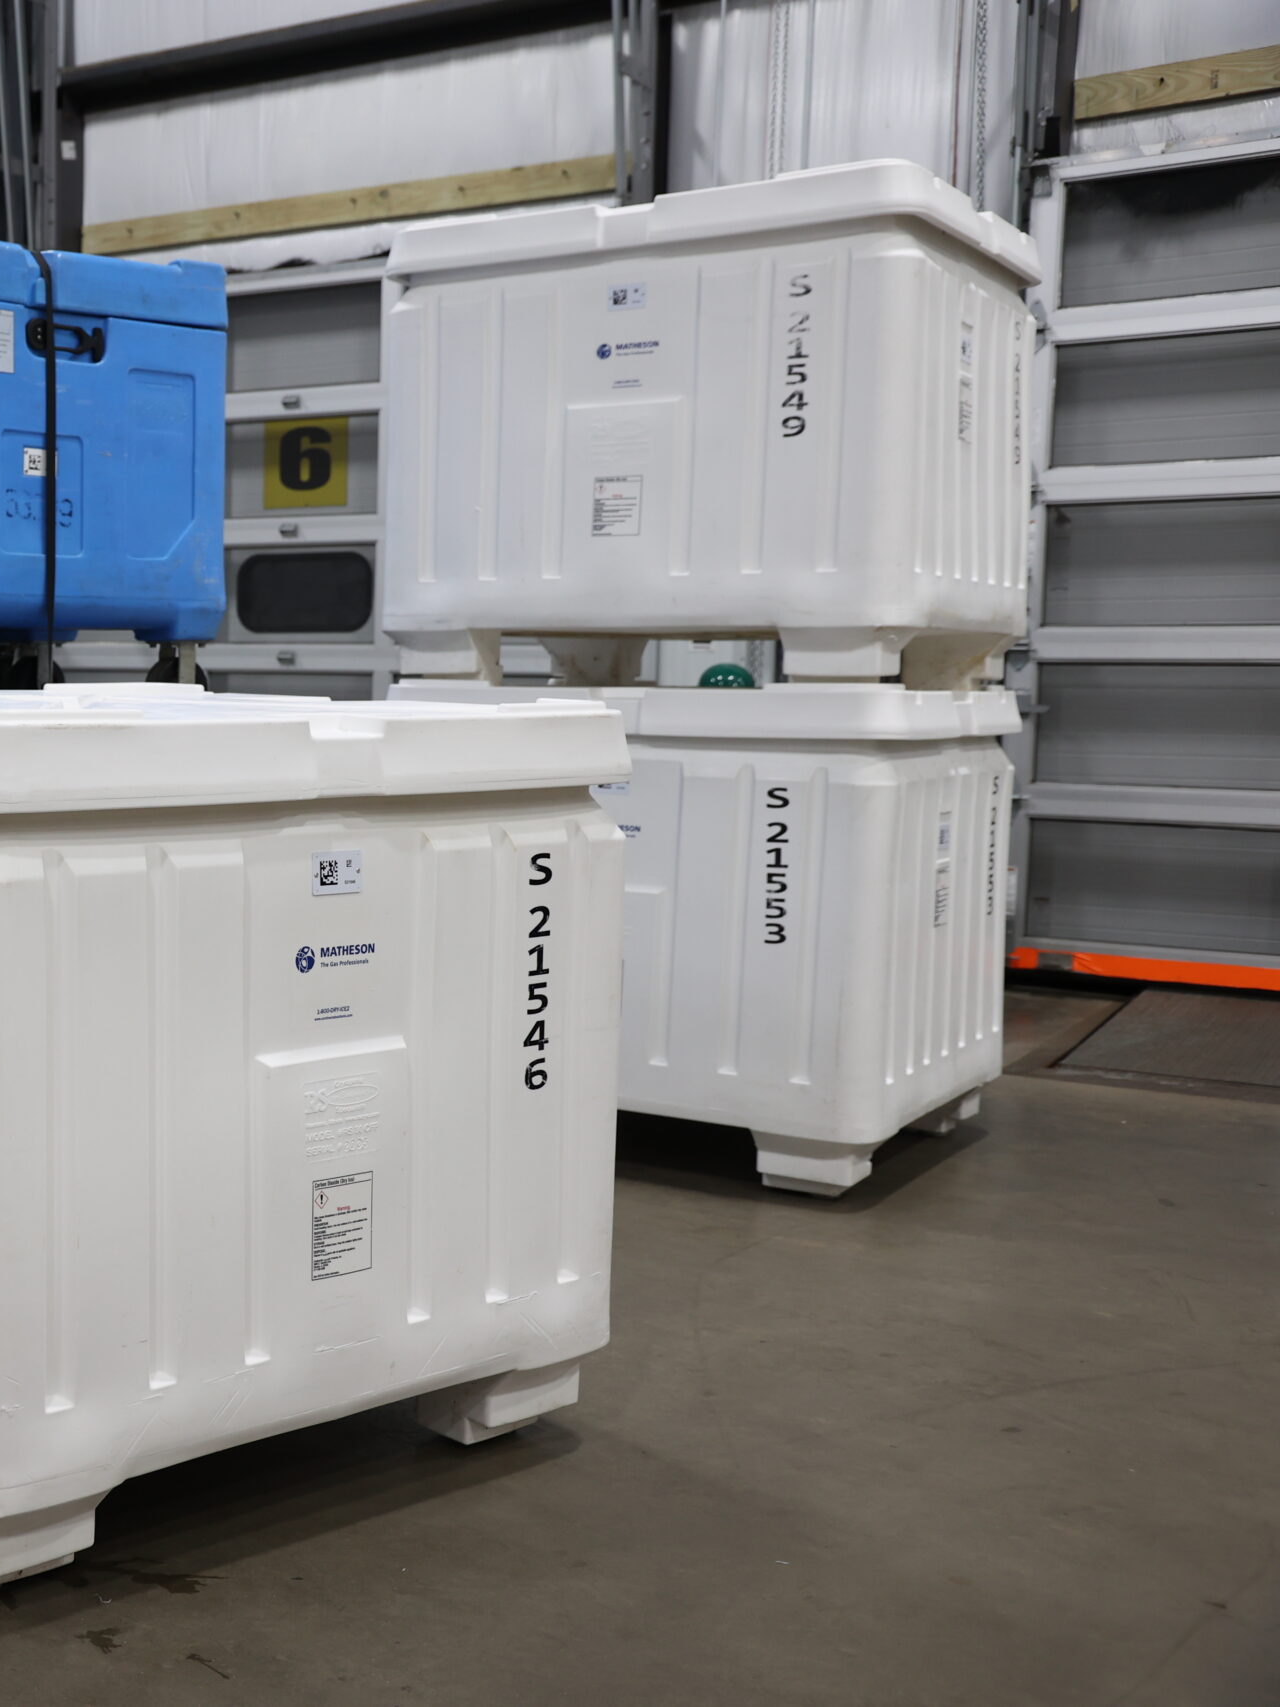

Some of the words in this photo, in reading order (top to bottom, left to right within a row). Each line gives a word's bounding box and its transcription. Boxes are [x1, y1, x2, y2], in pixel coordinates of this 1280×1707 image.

[789, 273, 813, 298] S
[781, 311, 811, 438] 21549
[280, 426, 332, 491] 6
[766, 787, 790, 809] S
[528, 853, 553, 886] S
[764, 822, 789, 944] 21553
[320, 943, 375, 958] MATHESON
[339, 958, 369, 966] Professionals
[522, 905, 551, 1090] 21546
